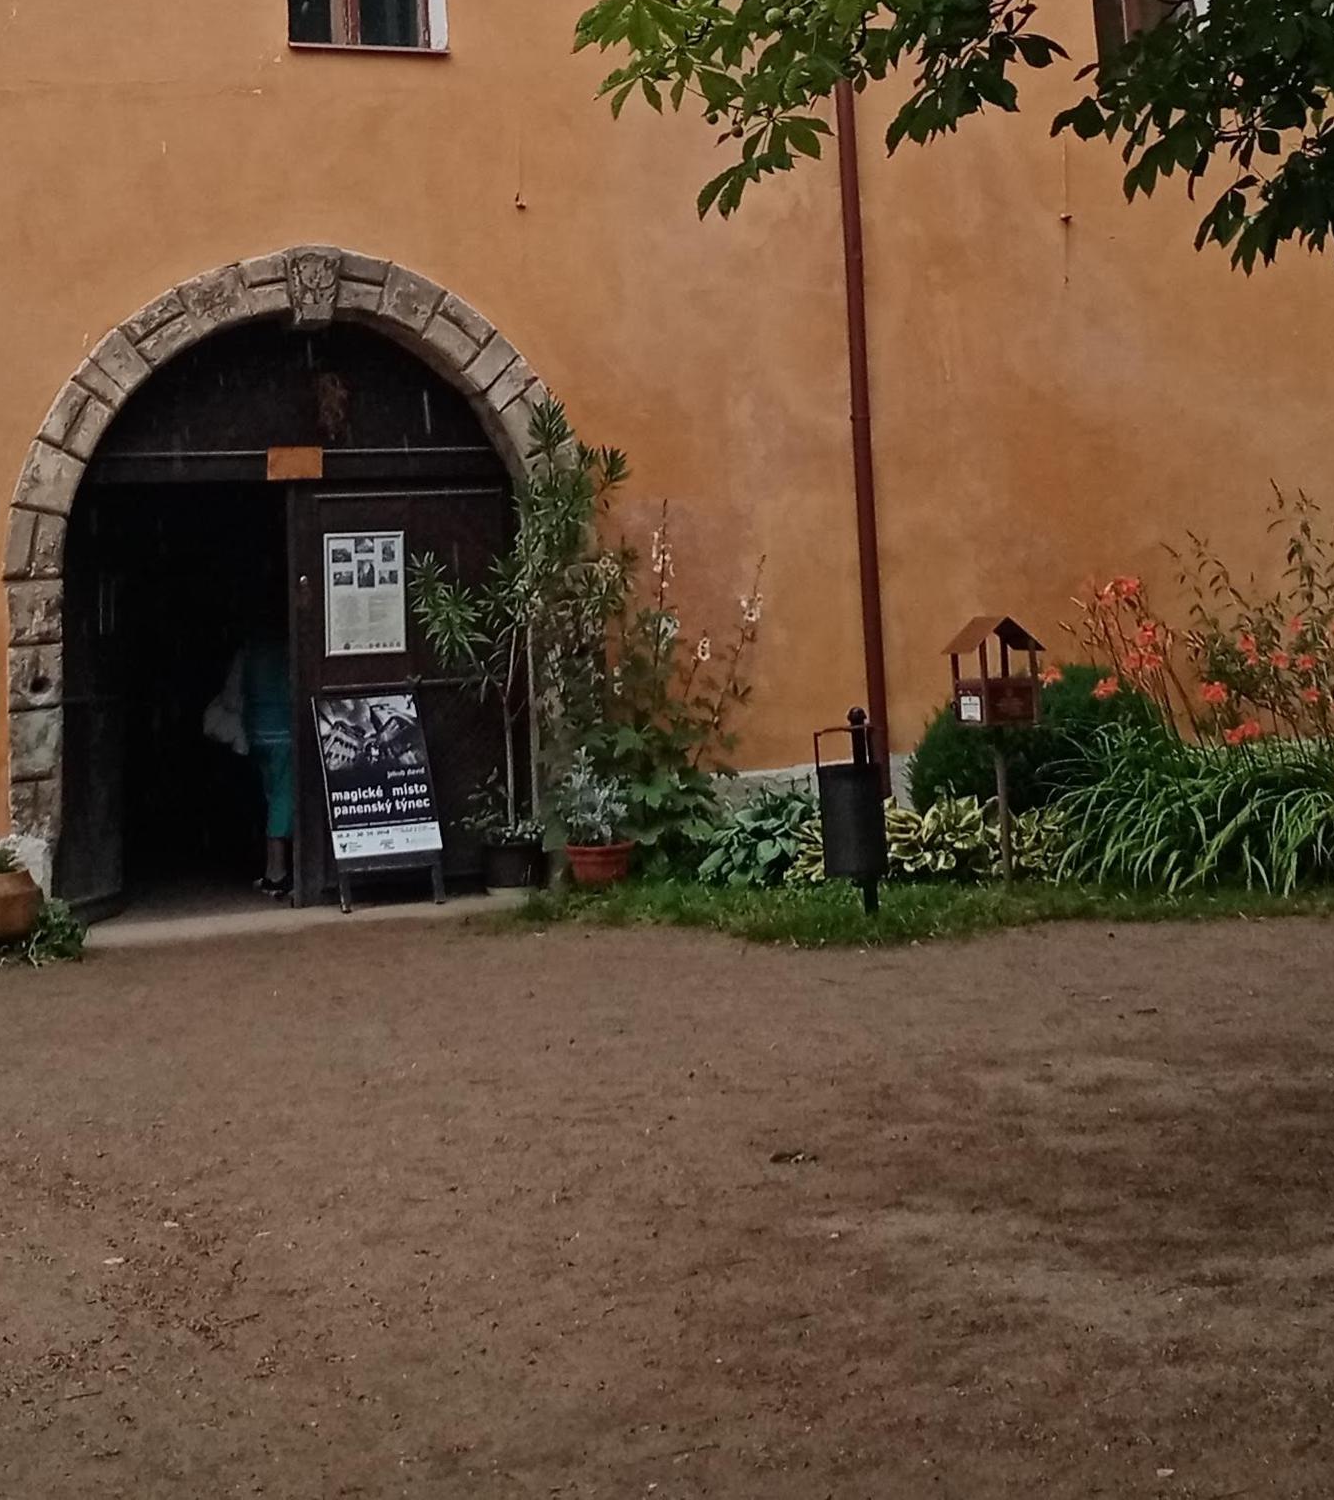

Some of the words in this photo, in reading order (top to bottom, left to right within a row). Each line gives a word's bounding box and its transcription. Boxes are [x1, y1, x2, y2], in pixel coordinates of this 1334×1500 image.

[331, 785, 383, 802] magické
[392, 783, 427, 796] místo
[334, 798, 393, 819] panenský
[395, 797, 431, 813] týnec
